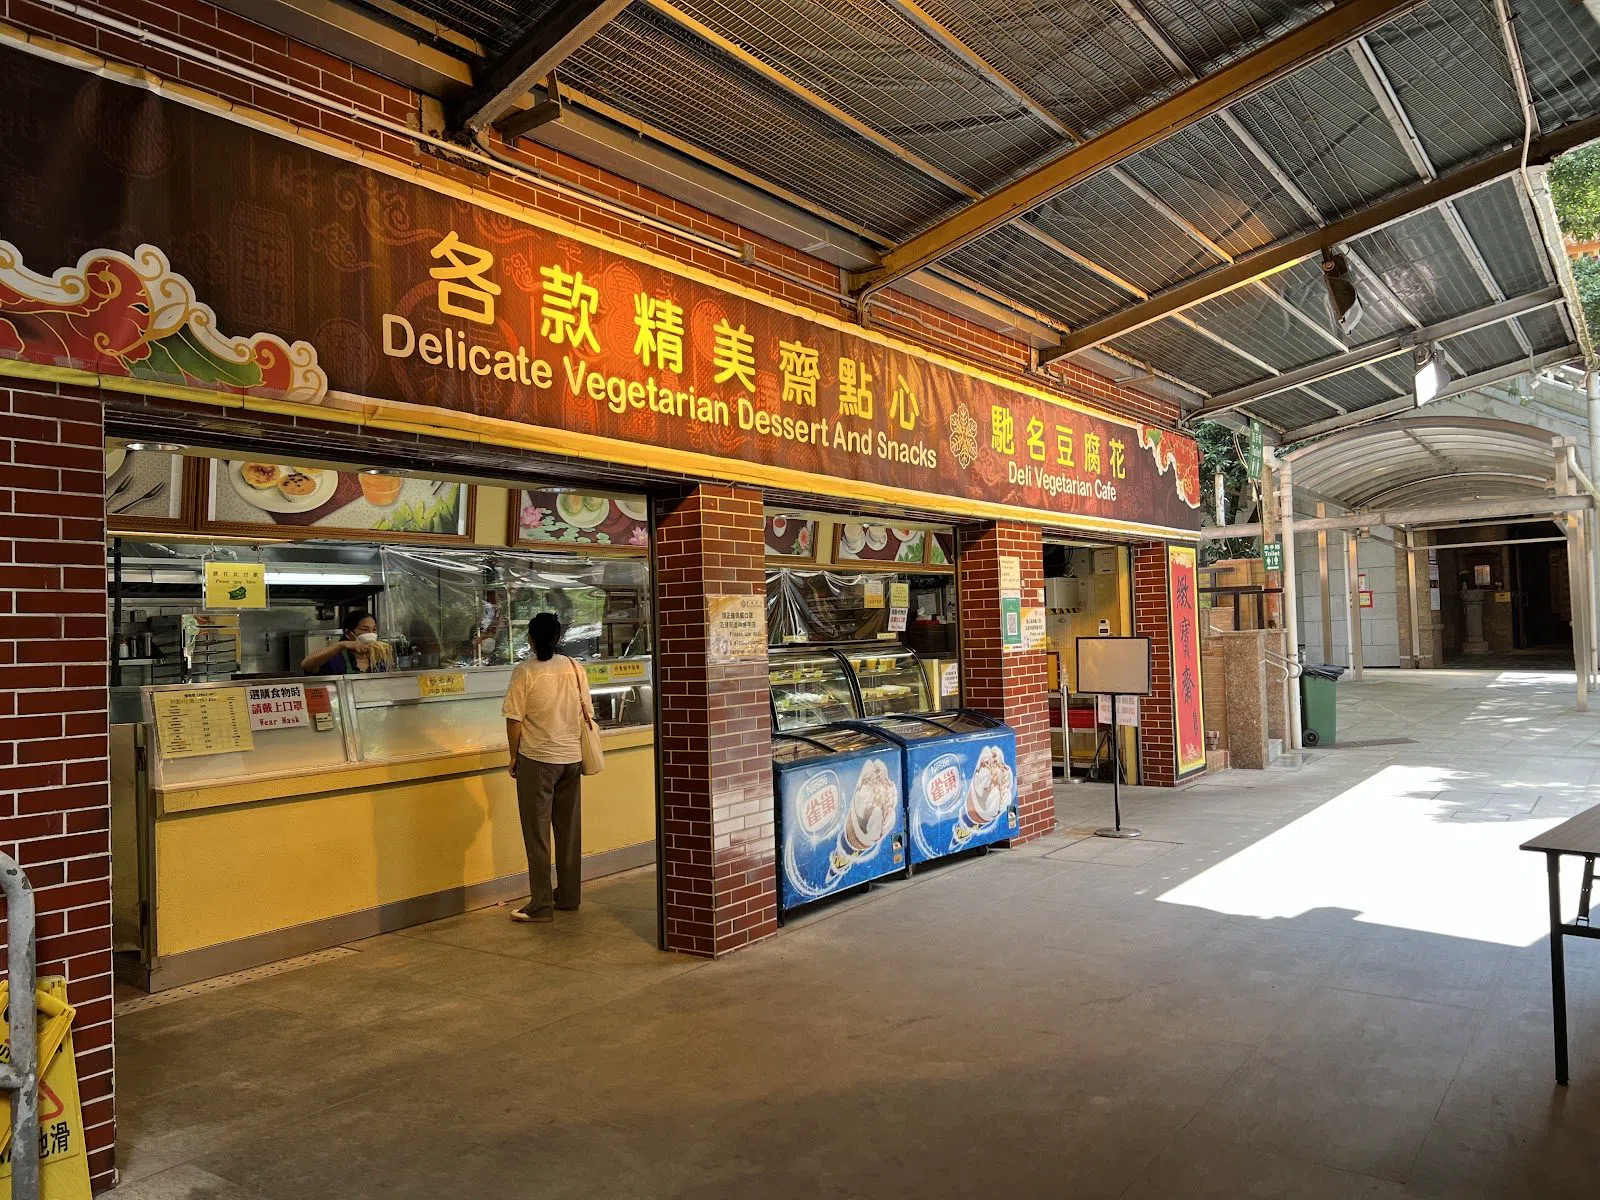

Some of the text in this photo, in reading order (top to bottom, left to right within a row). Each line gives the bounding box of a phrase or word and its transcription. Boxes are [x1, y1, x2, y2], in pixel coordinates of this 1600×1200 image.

[429, 230, 920, 431] 各款精美齋點心
[382, 313, 937, 470] Delicate Vegetarian Dessert And Snacks
[991, 404, 1126, 480] 馳名豆腐花
[1008, 460, 1117, 501] Deli Vegetarian Cafe
[250, 686, 301, 701] 選購食物時
[251, 700, 304, 715] 請戴上口罩
[259, 715, 301, 726] Wear Mask
[931, 757, 951, 775] Nestlé
[805, 774, 829, 794] Nestlé
[930, 768, 957, 802] 雀巢
[805, 787, 837, 827] 雀巢
